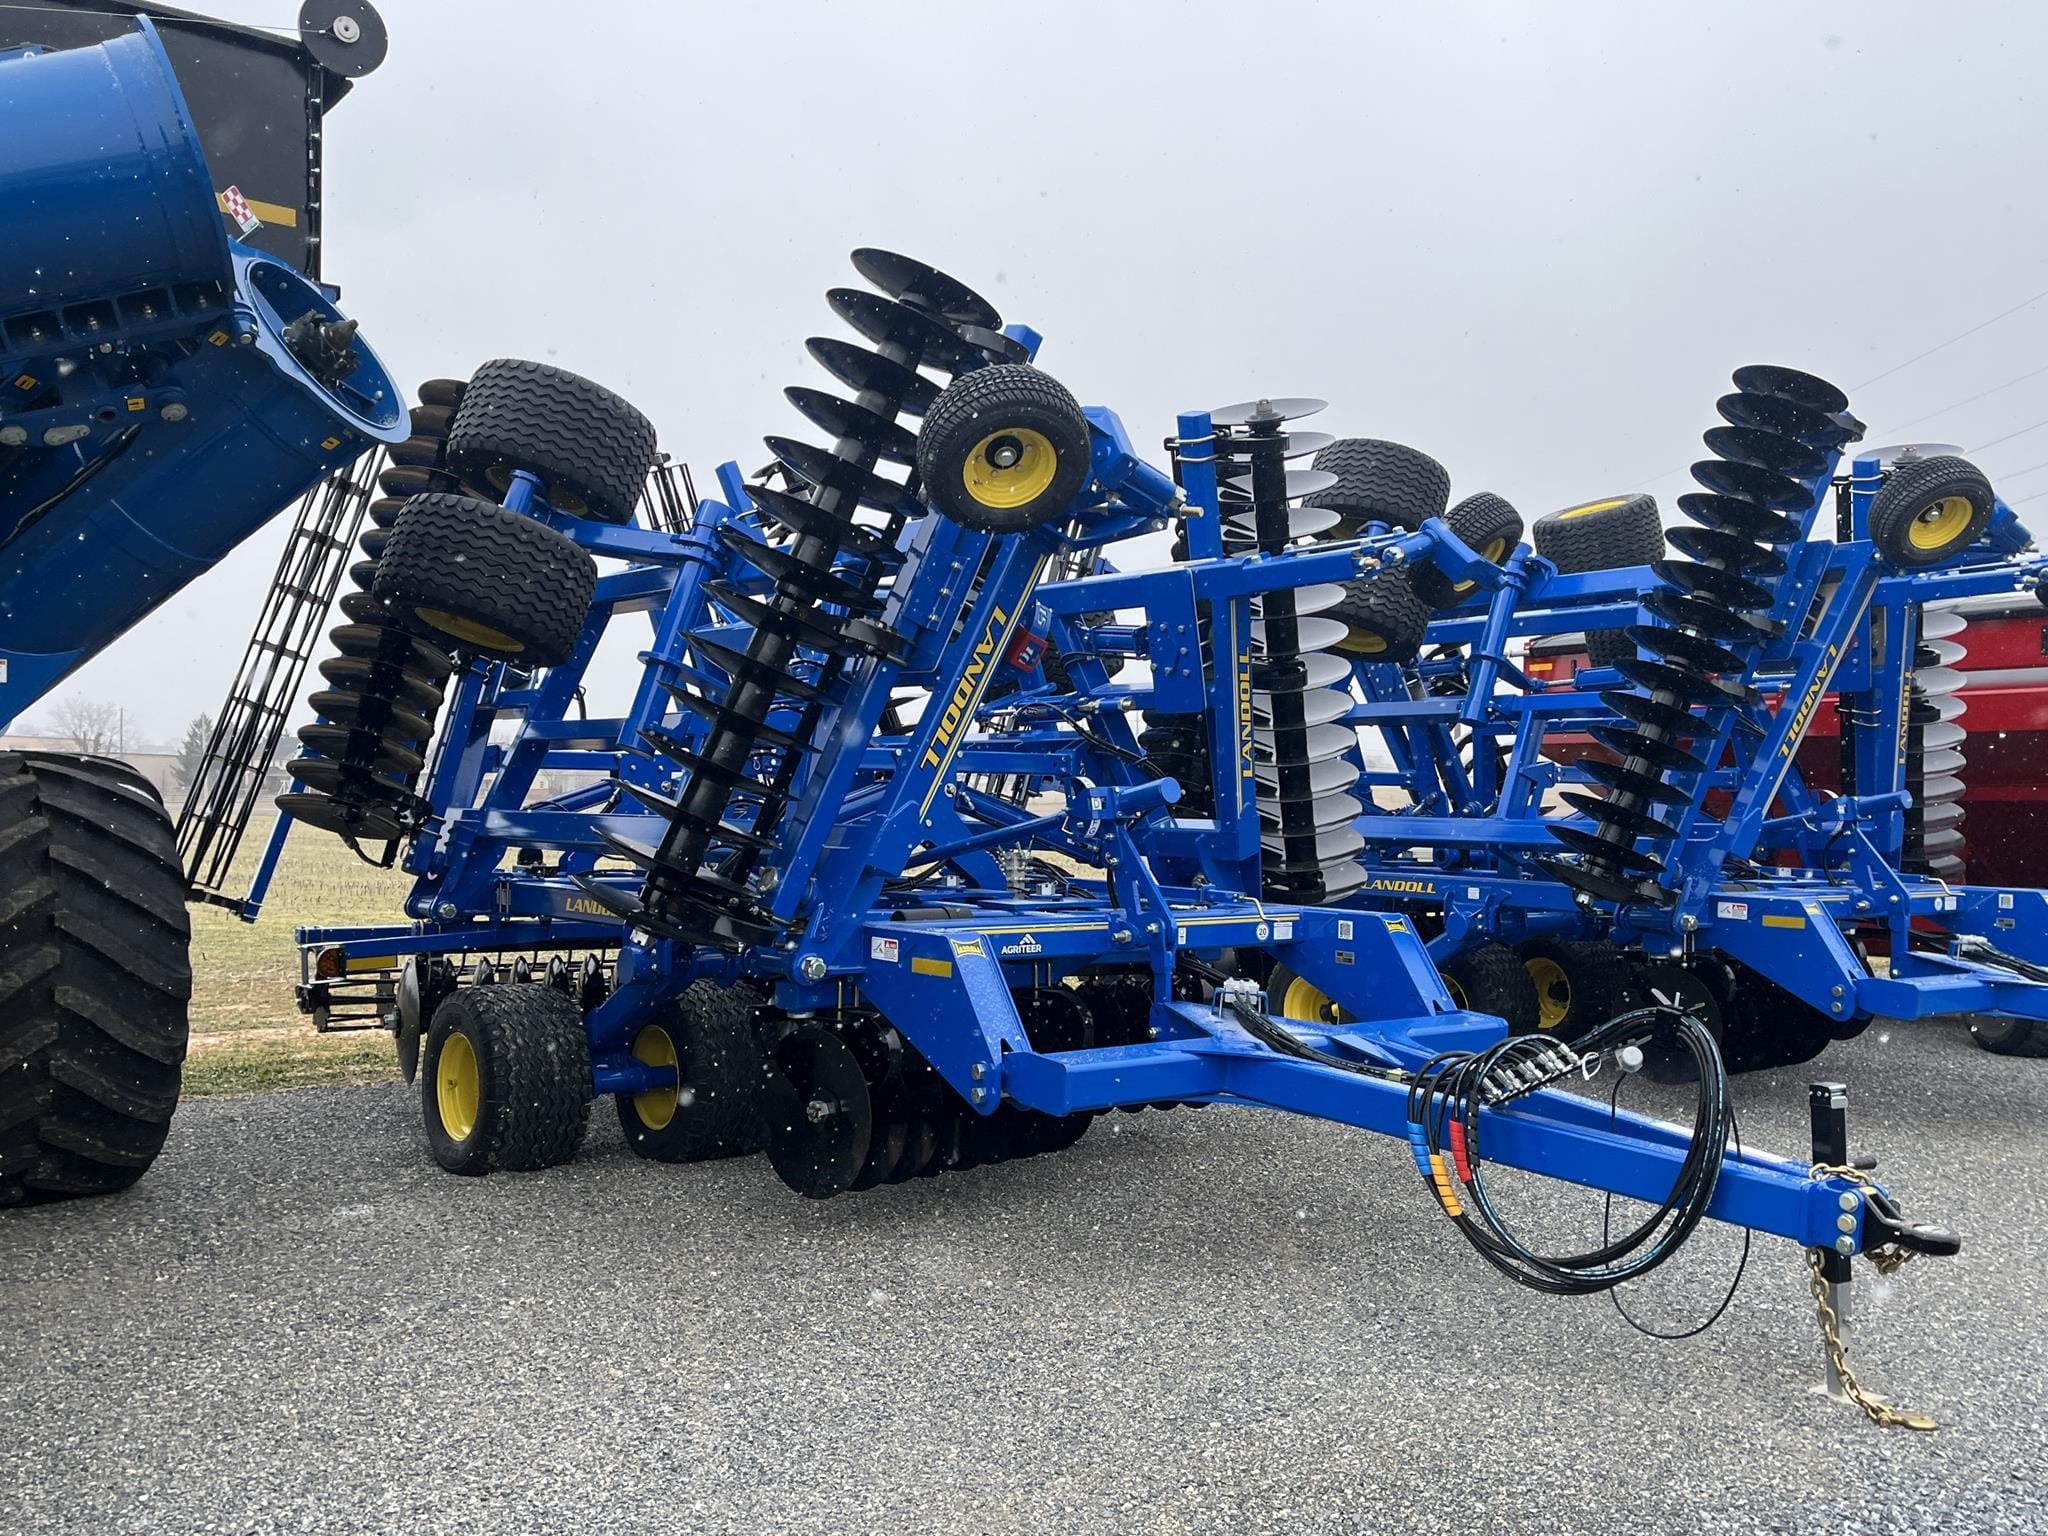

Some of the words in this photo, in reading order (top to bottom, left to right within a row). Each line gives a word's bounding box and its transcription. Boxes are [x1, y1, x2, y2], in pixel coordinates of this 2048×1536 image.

[920, 605, 1008, 769] LANDOLL
[1239, 646, 1253, 778] LANDOLL
[1778, 644, 1838, 758] LANDOLL
[1898, 666, 1911, 764] LANDOLL
[1361, 879, 1437, 894] LANDOLL
[1001, 943, 1042, 955] AGRITEER
